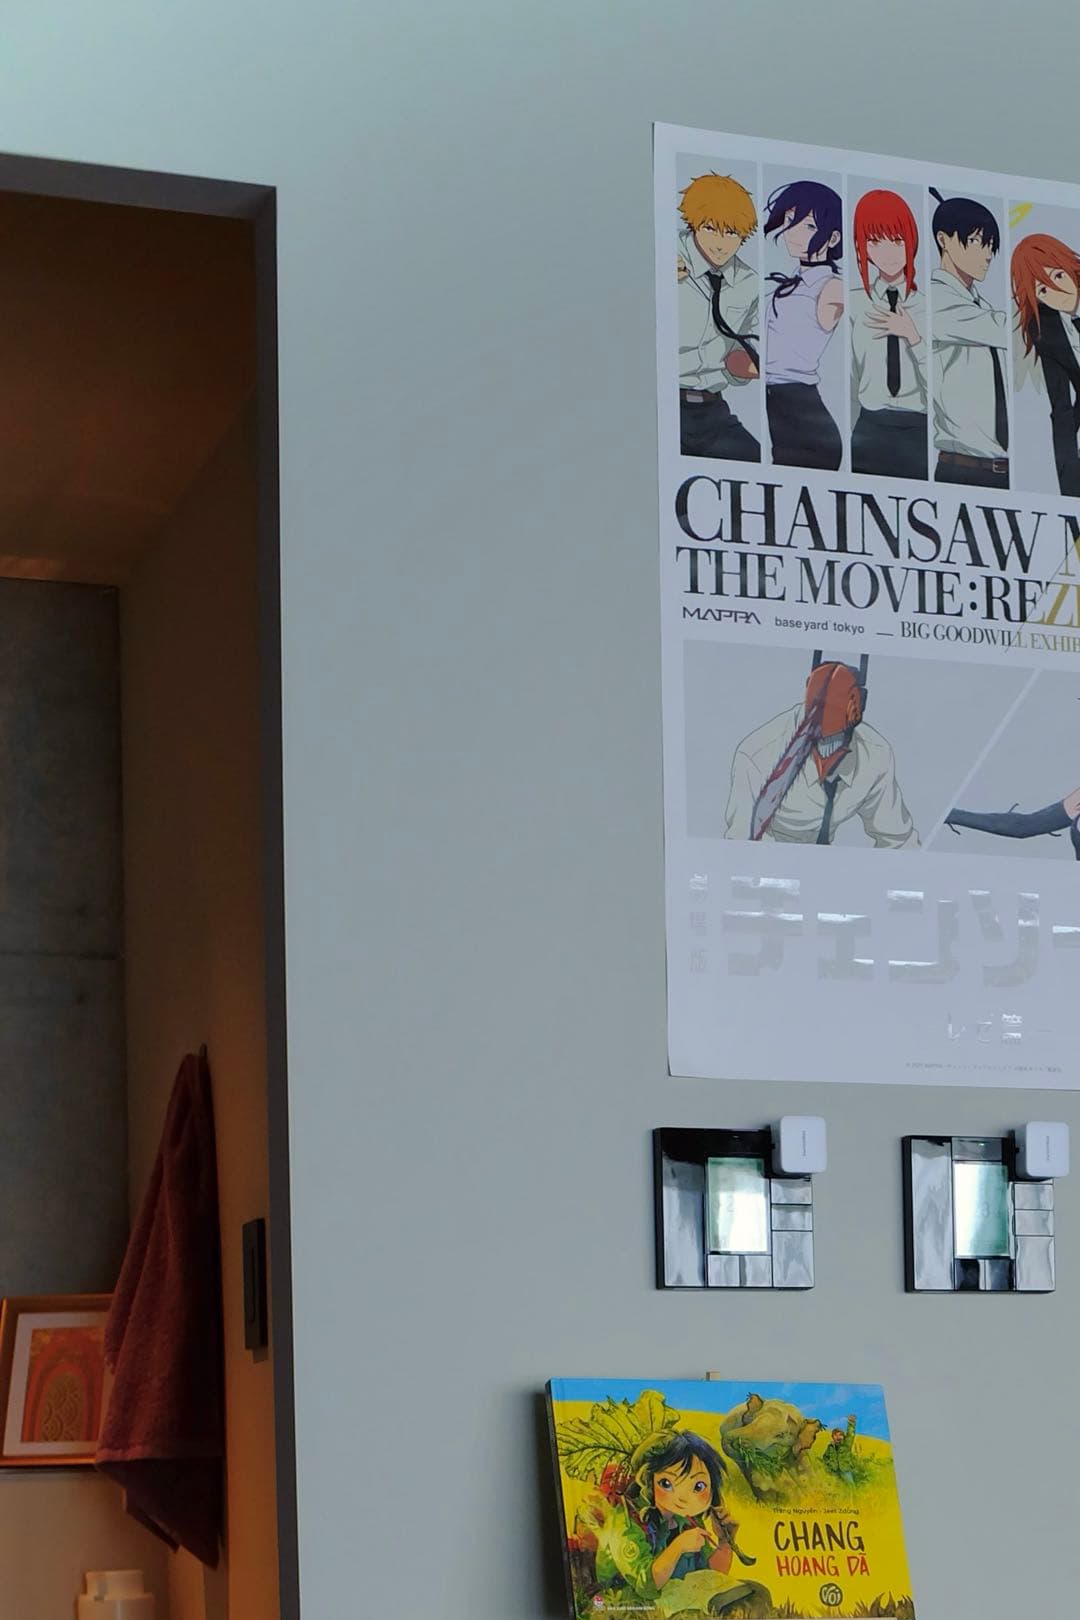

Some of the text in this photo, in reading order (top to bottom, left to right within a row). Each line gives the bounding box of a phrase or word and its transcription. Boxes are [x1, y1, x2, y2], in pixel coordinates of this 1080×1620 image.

[674, 474, 1046, 574] CHAINSAW
[676, 546, 786, 601] THE
[682, 605, 761, 626] MAPPA
[833, 622, 866, 635] tokyo
[901, 621, 930, 640] BIG
[933, 624, 1028, 649] GOODWILL
[774, 1521, 865, 1552] CHANG
[776, 1553, 871, 1577] HOANG DÃ
